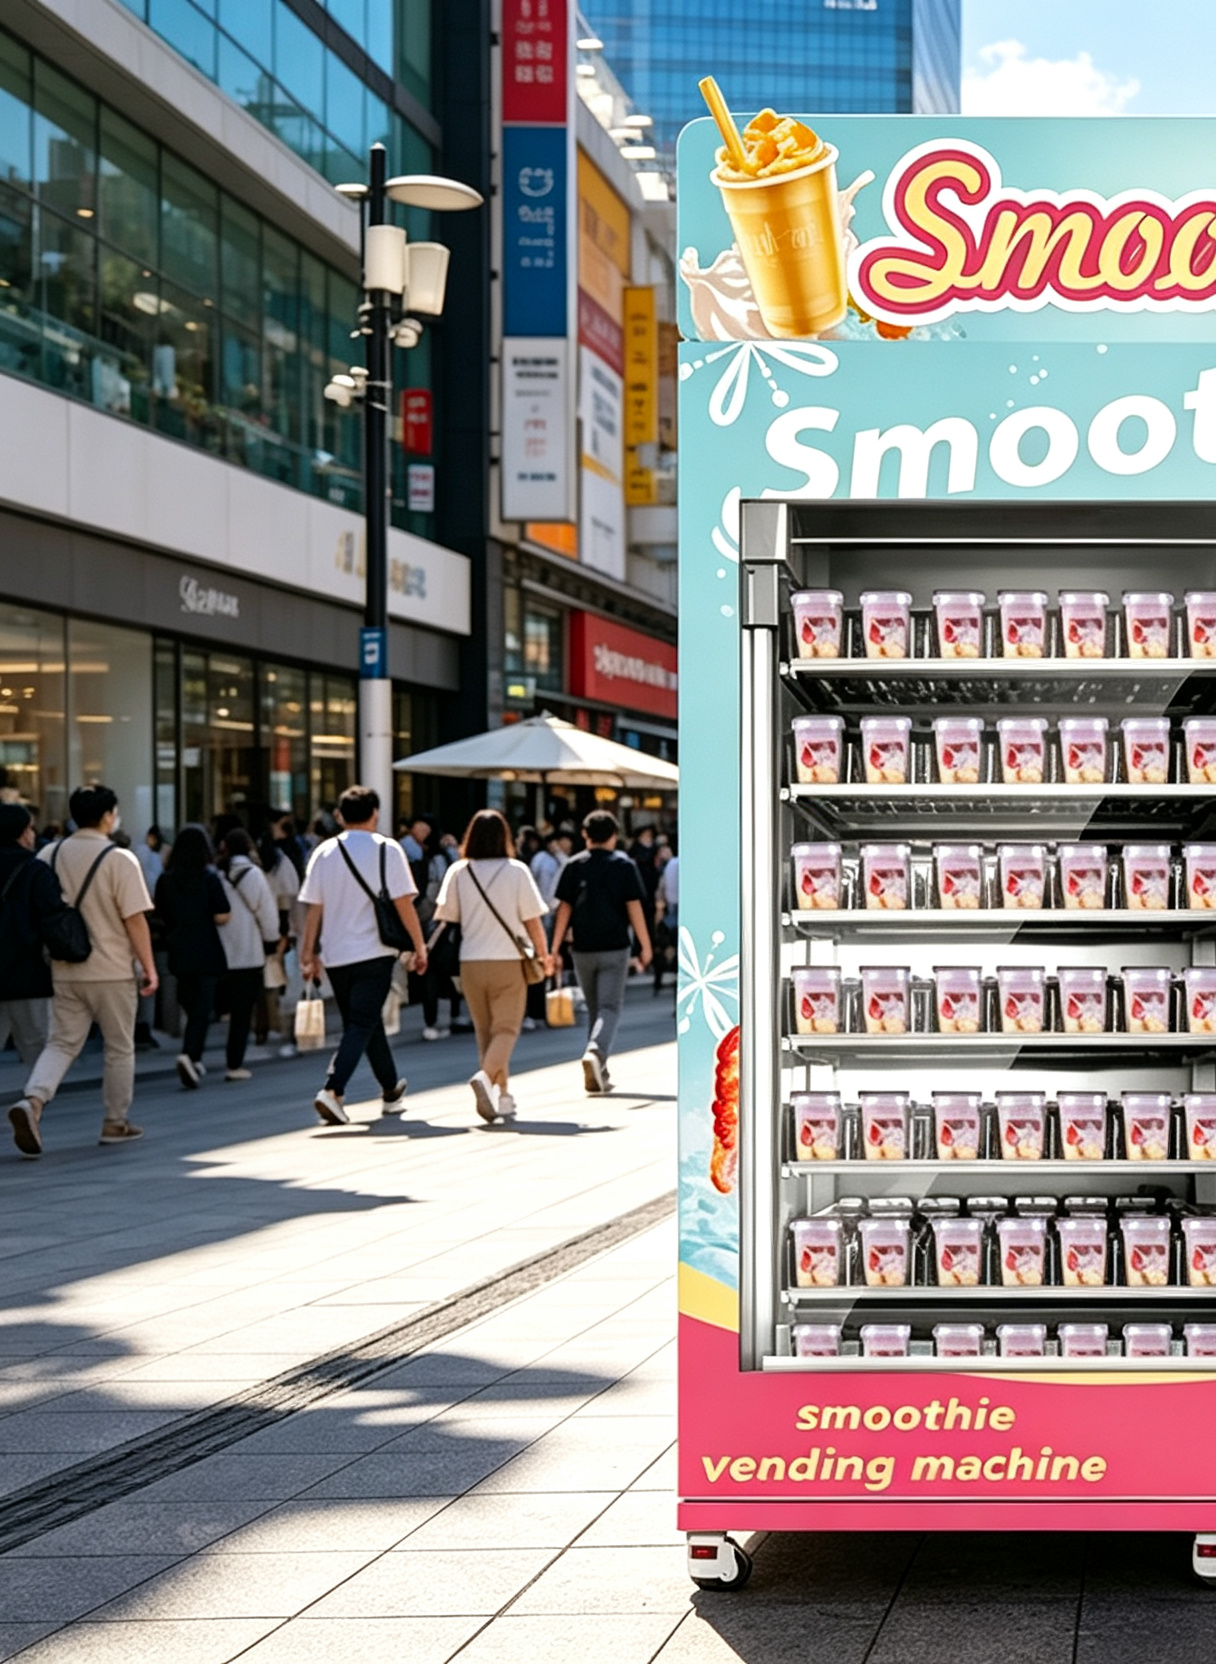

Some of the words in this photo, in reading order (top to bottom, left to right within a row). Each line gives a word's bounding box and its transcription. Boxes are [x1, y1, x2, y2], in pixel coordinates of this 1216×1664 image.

[795, 1397, 1016, 1432] smoothie
[701, 1446, 896, 1492] vending
[910, 1446, 1108, 1482] machine
